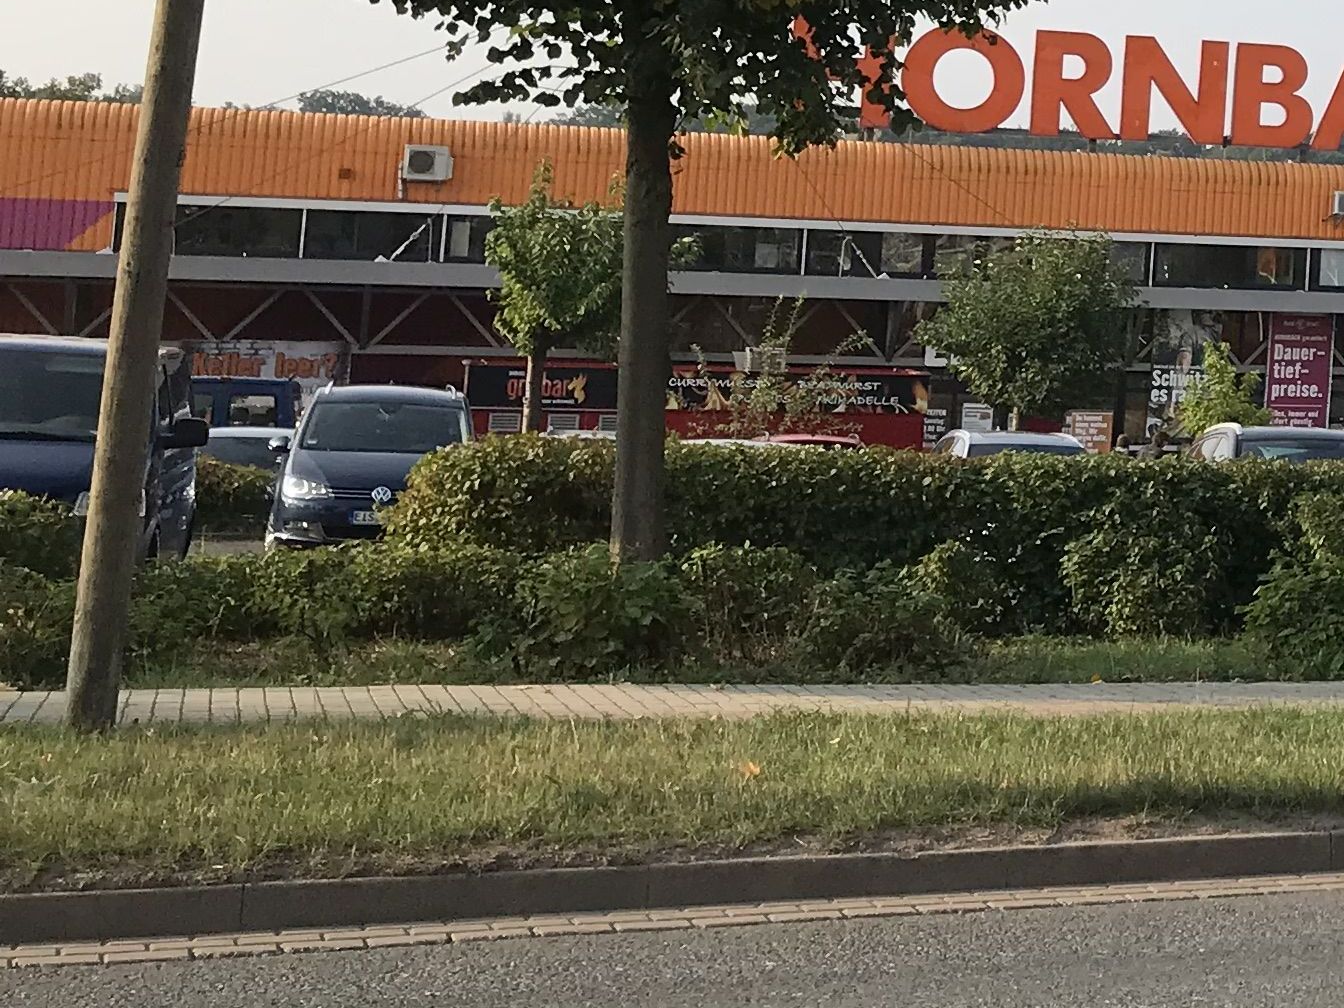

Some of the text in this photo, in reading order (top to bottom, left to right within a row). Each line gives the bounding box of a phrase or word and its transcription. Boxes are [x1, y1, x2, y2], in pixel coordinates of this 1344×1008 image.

[1273, 343, 1326, 361] Dauer-
[191, 352, 338, 379] Keller leer?
[1273, 362, 1310, 379] tief-
[507, 372, 569, 400] grbar
[1150, 388, 1169, 402] es
[1271, 381, 1323, 401] preise.
